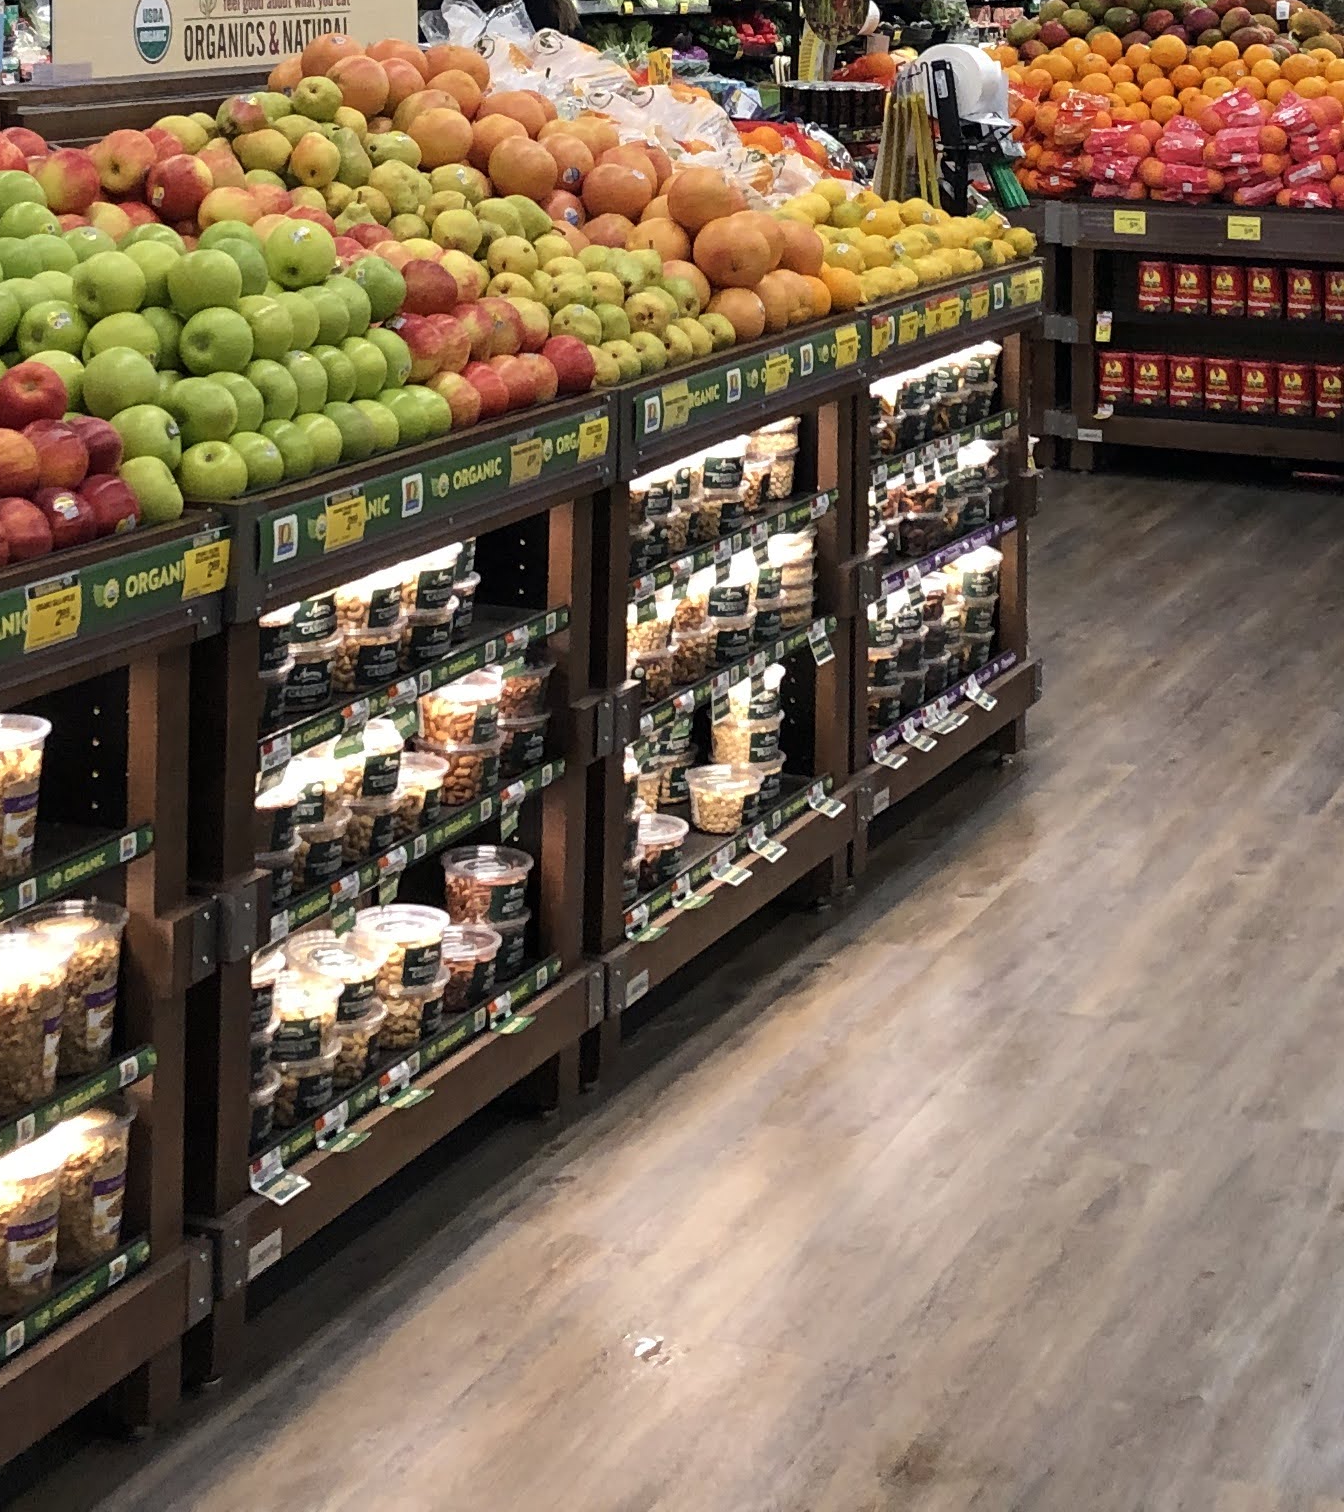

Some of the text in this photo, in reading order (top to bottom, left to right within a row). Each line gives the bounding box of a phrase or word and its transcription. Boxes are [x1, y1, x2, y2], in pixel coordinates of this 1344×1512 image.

[184, 21, 265, 62] ORGANICS
[269, 20, 280, 55] &
[453, 457, 503, 490] ORGANIC
[126, 559, 186, 598] ORGANI
